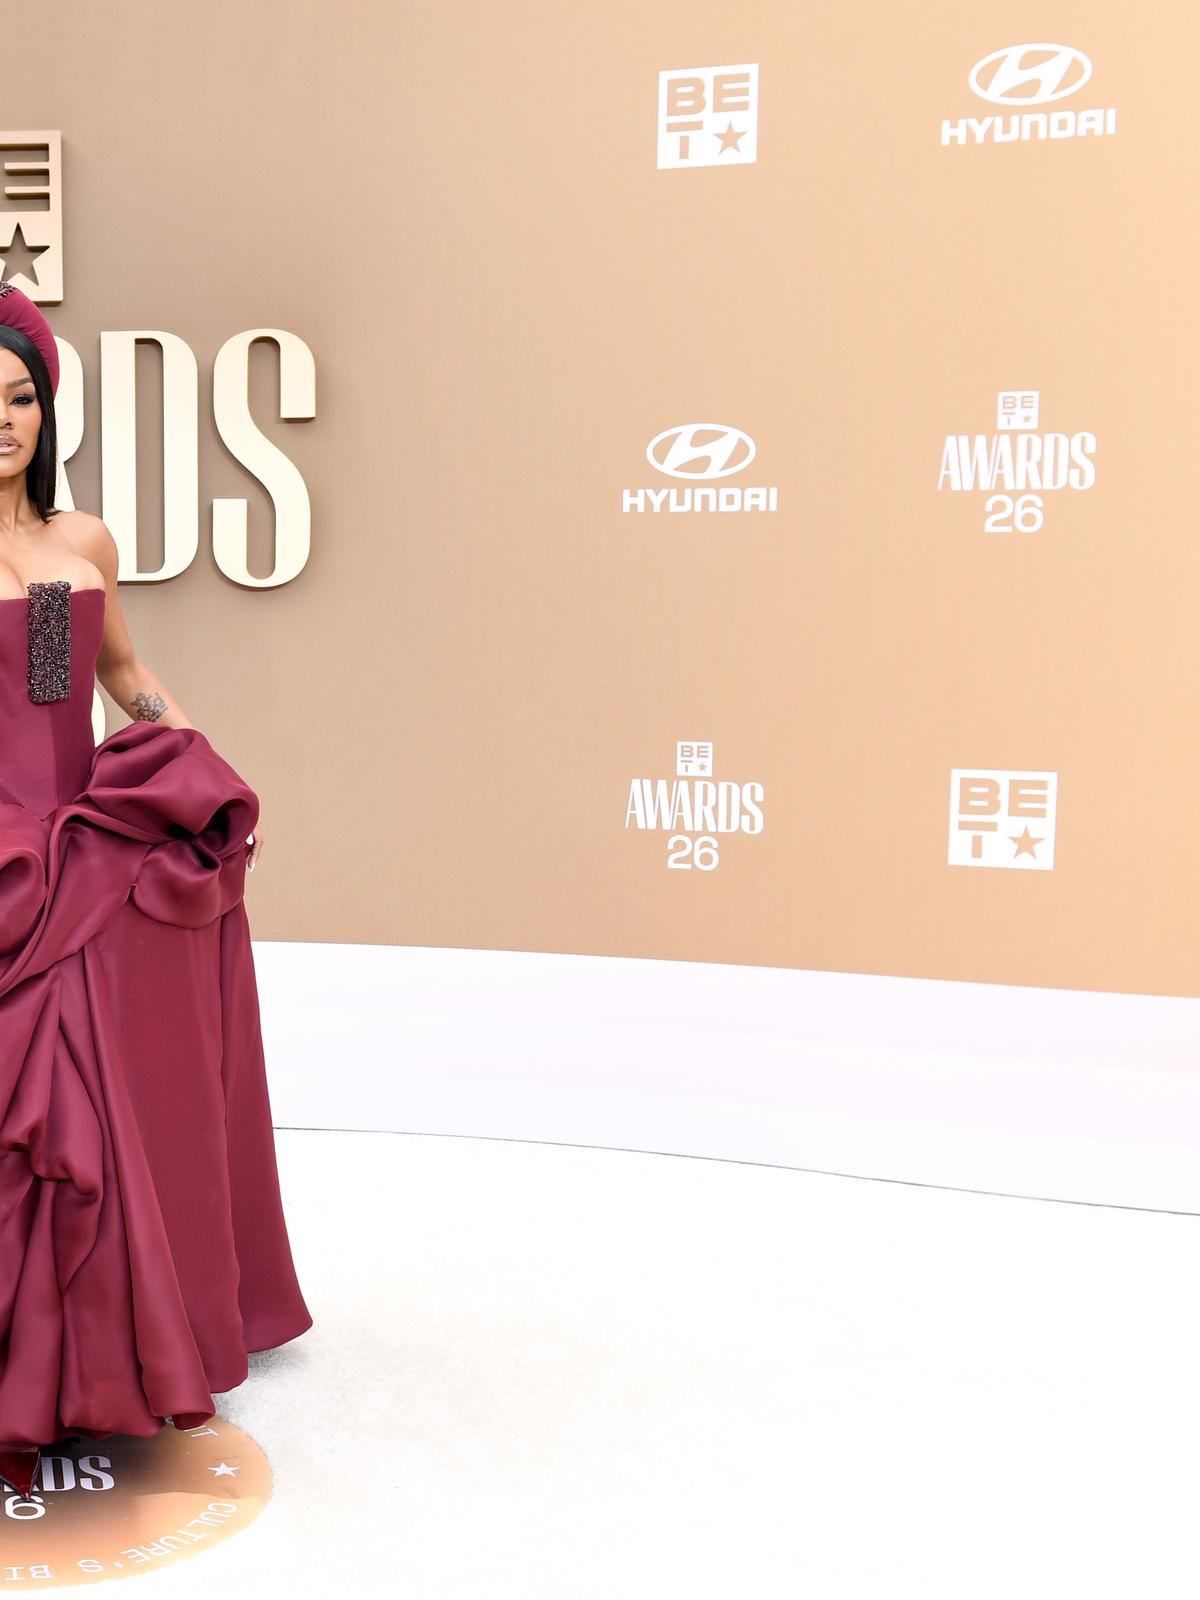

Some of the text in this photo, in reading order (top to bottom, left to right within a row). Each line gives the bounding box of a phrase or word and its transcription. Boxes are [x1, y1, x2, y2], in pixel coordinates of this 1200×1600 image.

[941, 108, 1117, 146] HYUNDAI
[937, 432, 1097, 491] AWARDS
[622, 487, 778, 513] HYUNDAI
[985, 494, 1044, 533] 26
[625, 778, 764, 834] AWARDS
[667, 834, 719, 871] 26
[77, 1502, 237, 1574] CULTURE'S
